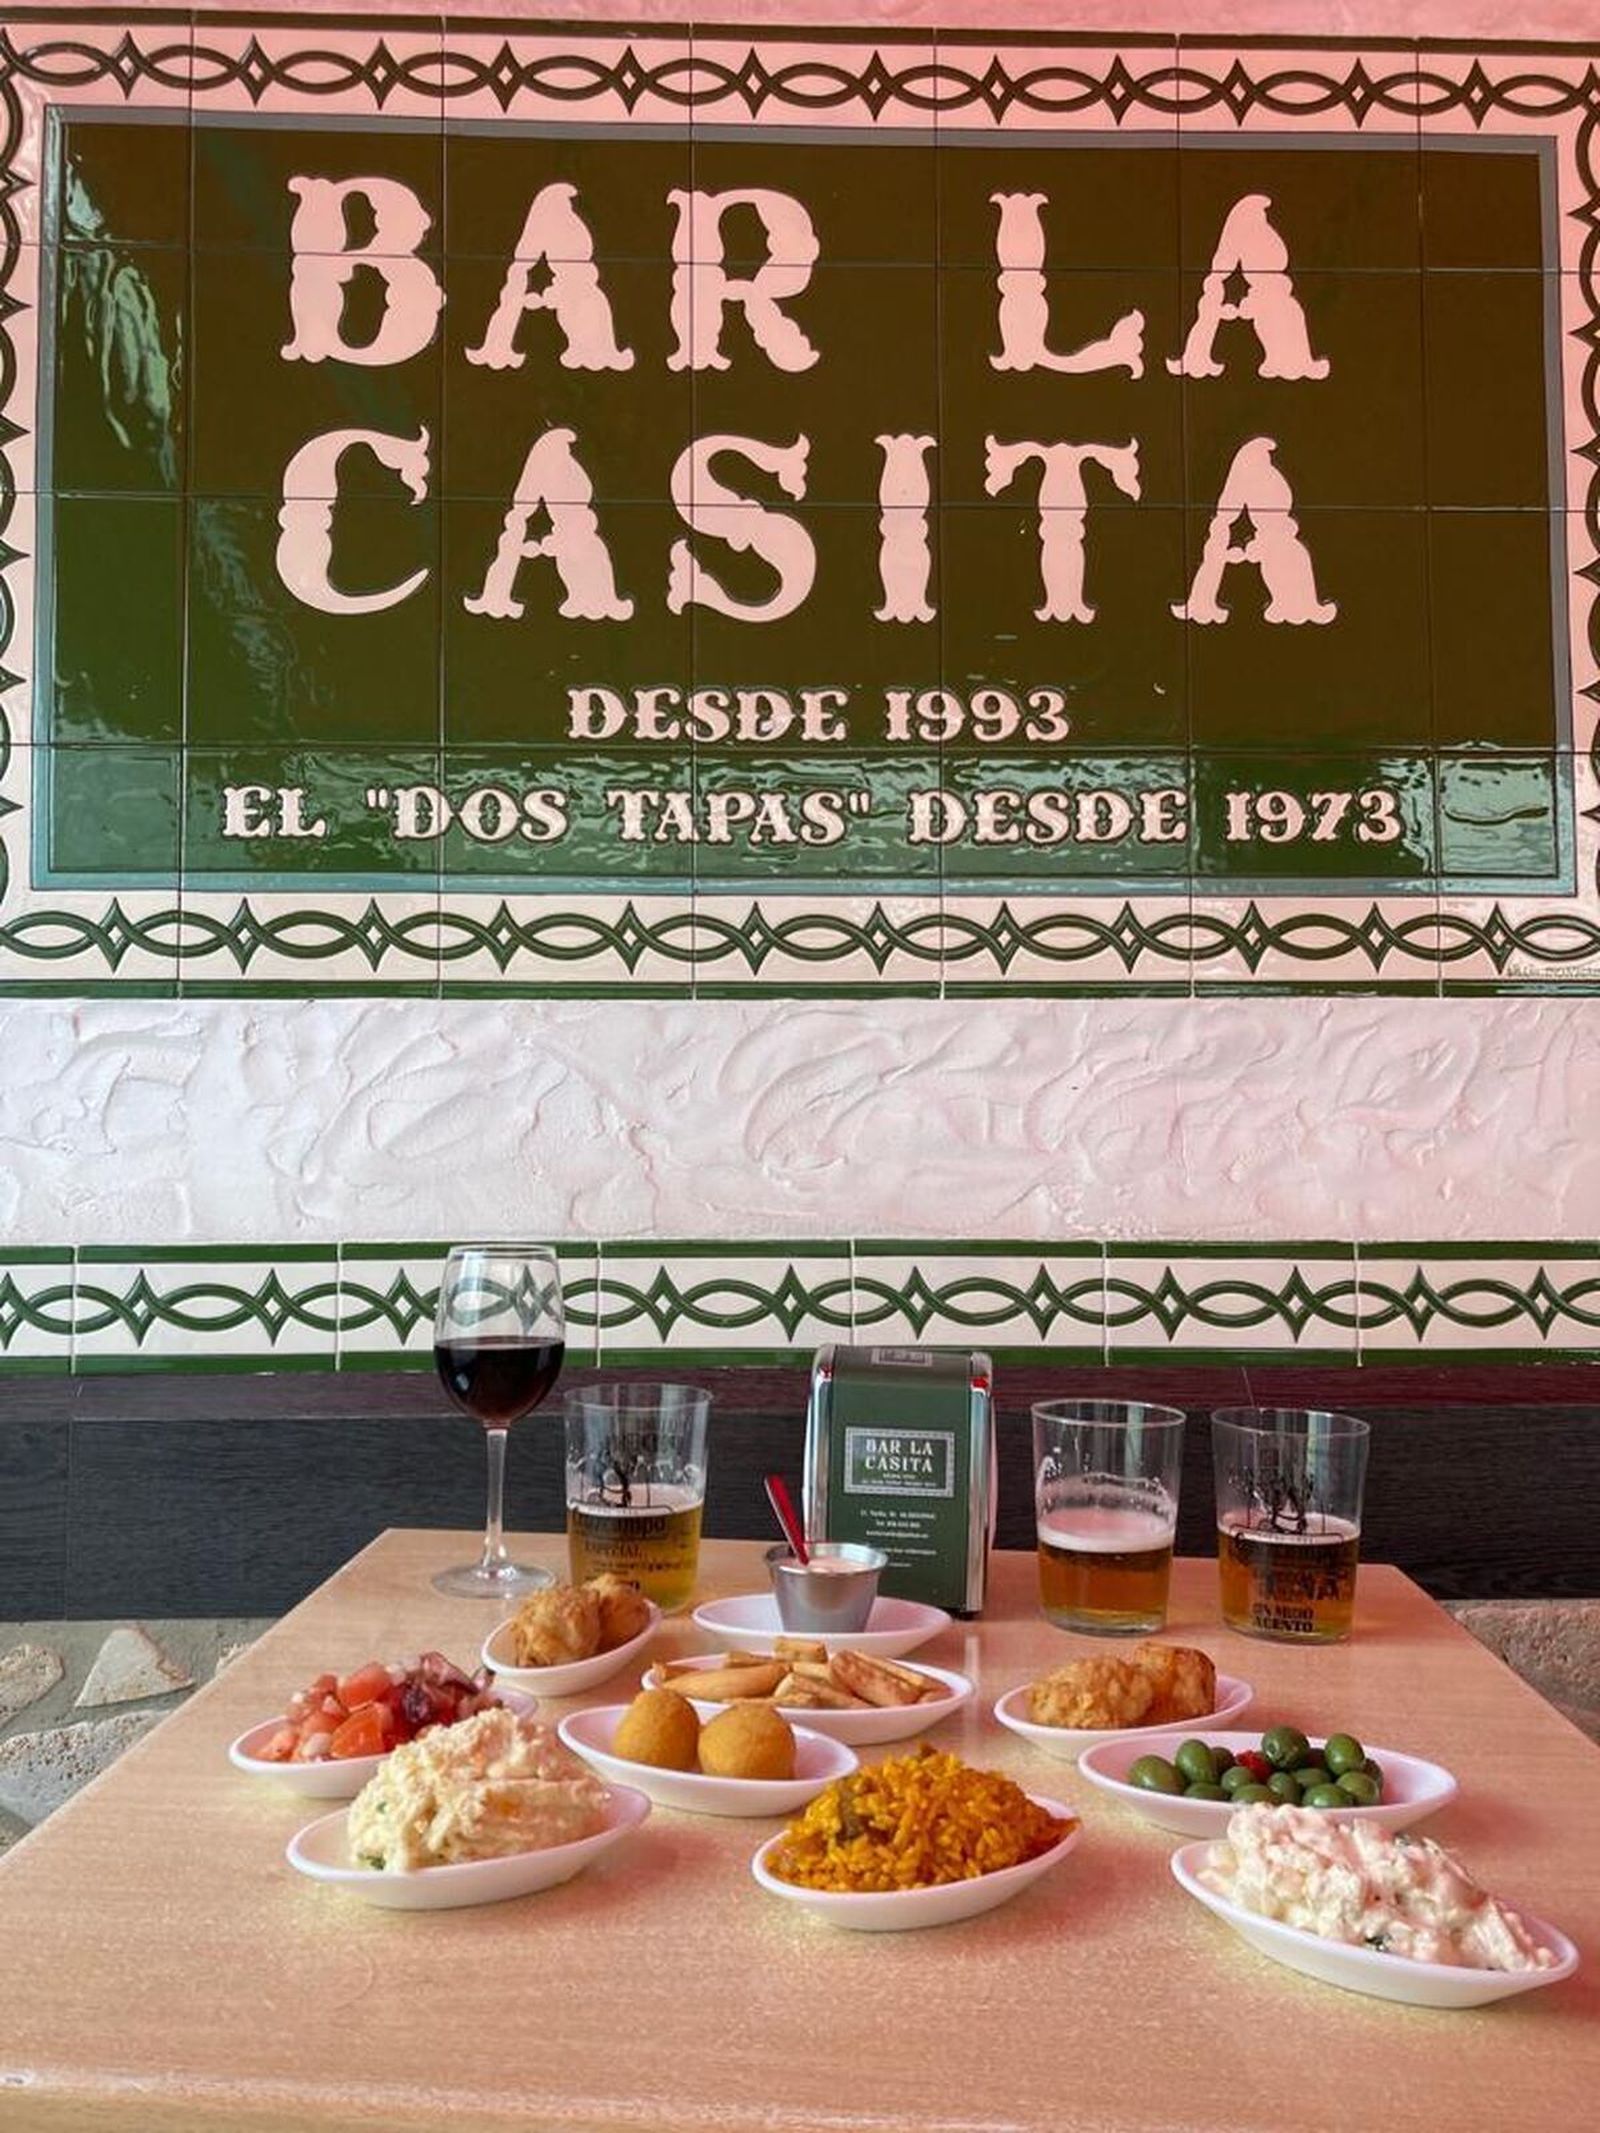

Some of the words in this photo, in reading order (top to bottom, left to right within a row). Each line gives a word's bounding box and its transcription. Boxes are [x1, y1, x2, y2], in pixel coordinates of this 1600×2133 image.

[280, 175, 821, 373] BAR
[988, 192, 1331, 381] LA
[275, 424, 1338, 626] CASITA
[566, 687, 848, 742] DESDE
[885, 689, 1070, 742] 1993
[221, 785, 327, 839] EL
[365, 785, 570, 842] "DOS
[606, 789, 871, 844] TAPAS"
[908, 789, 1188, 845] DESDE
[1224, 790, 1402, 844] 1973
[864, 1455, 933, 1472] CASITA
[865, 1438, 901, 1454] BAR
[909, 1440, 934, 1456] LA
